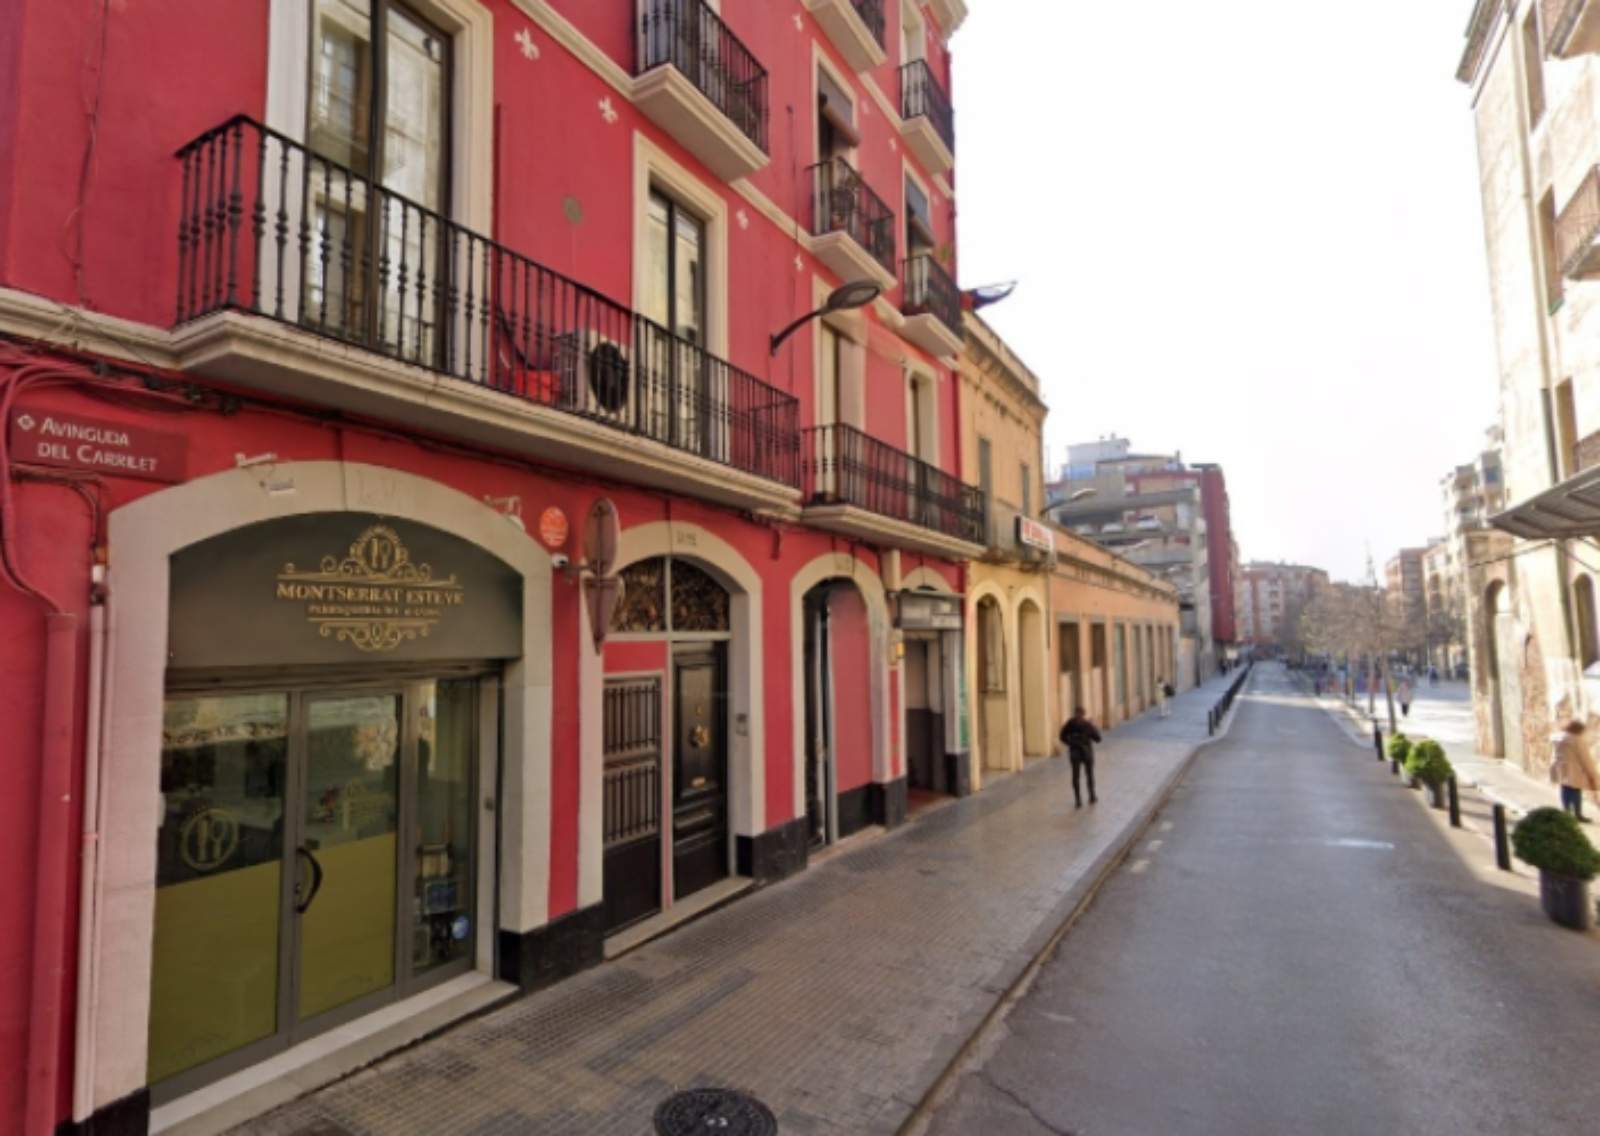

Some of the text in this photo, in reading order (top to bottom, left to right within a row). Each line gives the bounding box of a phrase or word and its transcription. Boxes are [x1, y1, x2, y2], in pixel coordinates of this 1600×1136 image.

[40, 417, 130, 446] AVINGUDA
[38, 442, 158, 472] DEL CARRILET
[276, 583, 464, 605] MONTSERRAT ESTEVE
